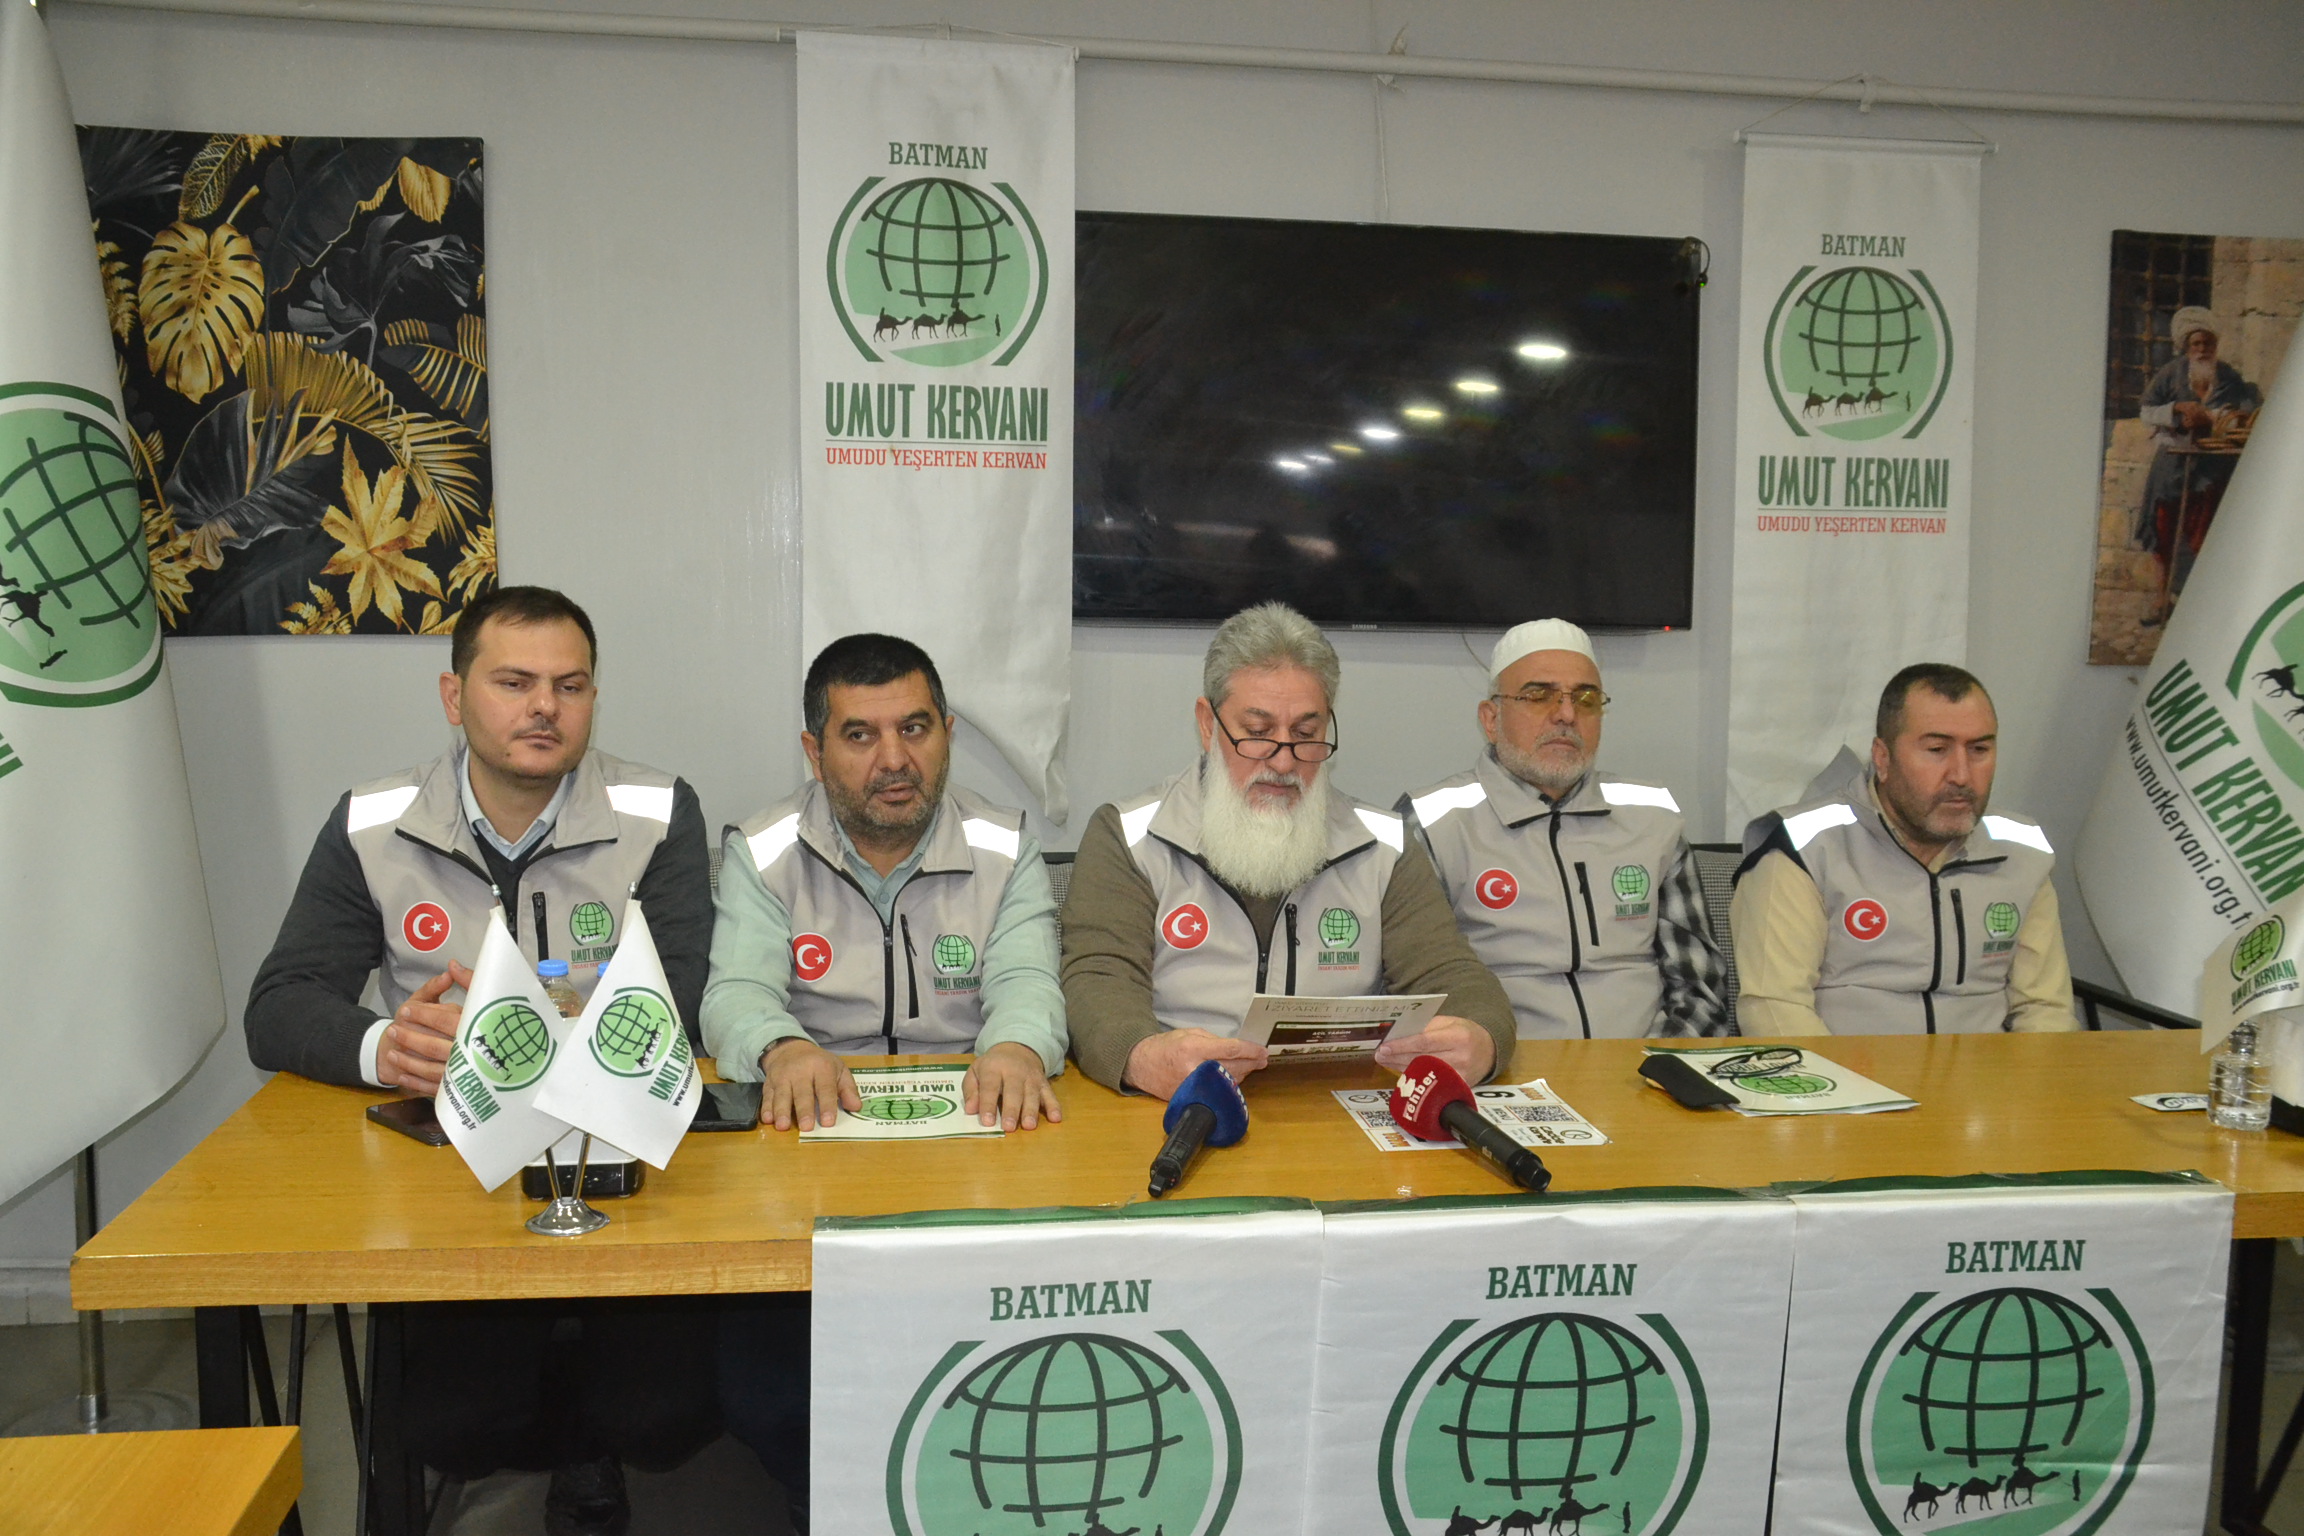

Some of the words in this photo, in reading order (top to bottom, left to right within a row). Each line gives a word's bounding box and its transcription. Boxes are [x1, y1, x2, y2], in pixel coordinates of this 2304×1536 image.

[889, 142, 988, 170] BATMAN
[1821, 234, 1906, 258] BATMAN
[826, 381, 915, 438] UMUT
[927, 384, 1048, 441] KERVANI
[826, 447, 887, 465] UMUDU
[892, 449, 978, 471] YEŞERTEN
[982, 451, 1047, 470] KERVAN
[1758, 455, 1836, 506] UMUT
[1844, 457, 1949, 508] KERVANI
[1757, 515, 1811, 532] UMUDU
[1815, 516, 1886, 537] YEŞERTEN
[1890, 517, 1946, 534] KERVAN
[2146, 658, 2240, 771] UMUT
[2191, 756, 2304, 904] KERVAN
[571, 948, 591, 962] UMUT
[454, 1068, 502, 1123] KERVANI
[648, 1062, 684, 1101] UMUT
[858, 1084, 904, 1094] KERVA
[911, 1084, 955, 1093] UMUT
[1403, 1070, 1438, 1121] rehber
[1945, 1239, 2087, 1274] BATMAN
[989, 1278, 1152, 1321] BATMAN
[1485, 1263, 1639, 1301] BATMAN
